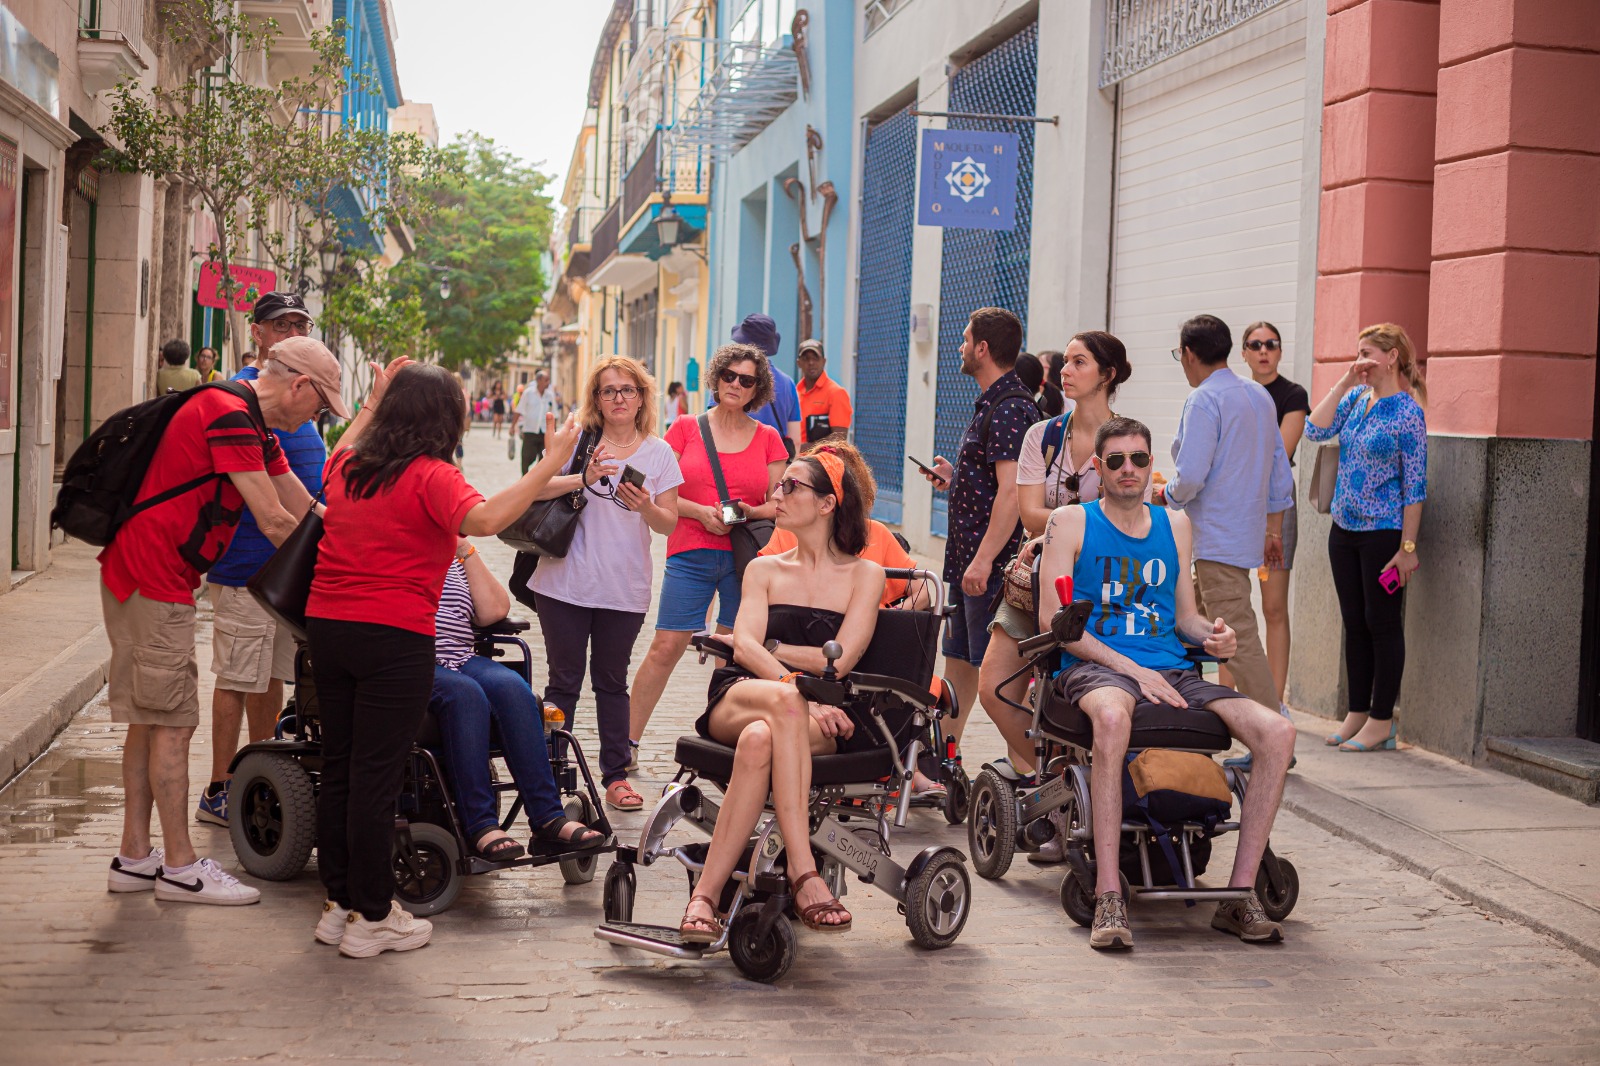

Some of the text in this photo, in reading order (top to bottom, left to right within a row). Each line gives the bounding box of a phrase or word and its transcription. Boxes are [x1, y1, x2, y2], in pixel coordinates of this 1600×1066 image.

[934, 141, 984, 153] MAQUETA
[1095, 556, 1167, 587] TRO
[836, 837, 878, 873] Sorolla
